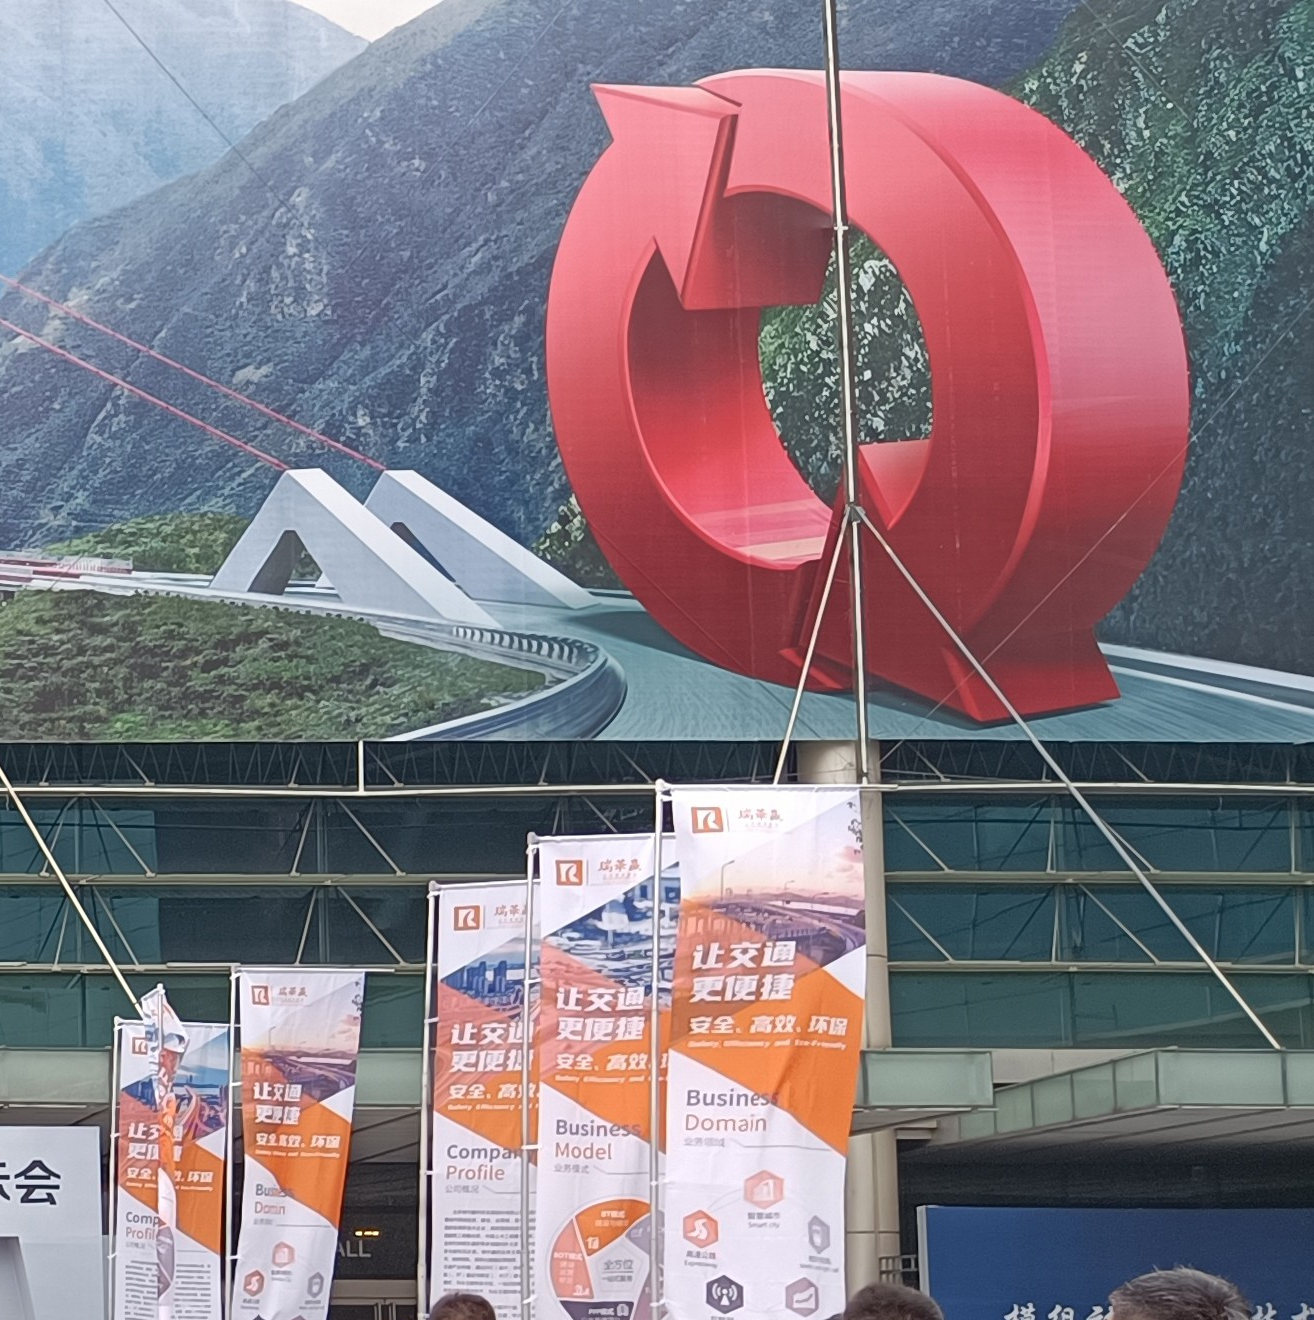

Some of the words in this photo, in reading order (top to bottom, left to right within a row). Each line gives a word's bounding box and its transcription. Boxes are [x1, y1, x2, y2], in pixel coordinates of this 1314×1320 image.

[692, 941, 796, 969] 让交通
[689, 973, 796, 1003] 更便捷
[556, 986, 645, 1012] 让交通
[556, 1016, 645, 1041] 更便捷
[689, 1015, 848, 1036] 安全、高效、环保
[253, 1082, 303, 1102] 让交通
[686, 1088, 779, 1107] Business
[556, 1119, 641, 1137] Business
[684, 1113, 768, 1132] Domain
[555, 1142, 612, 1160] Model
[446, 1164, 505, 1181] Profile
[125, 1211, 159, 1230] Comp
[125, 1226, 158, 1241] Profil
